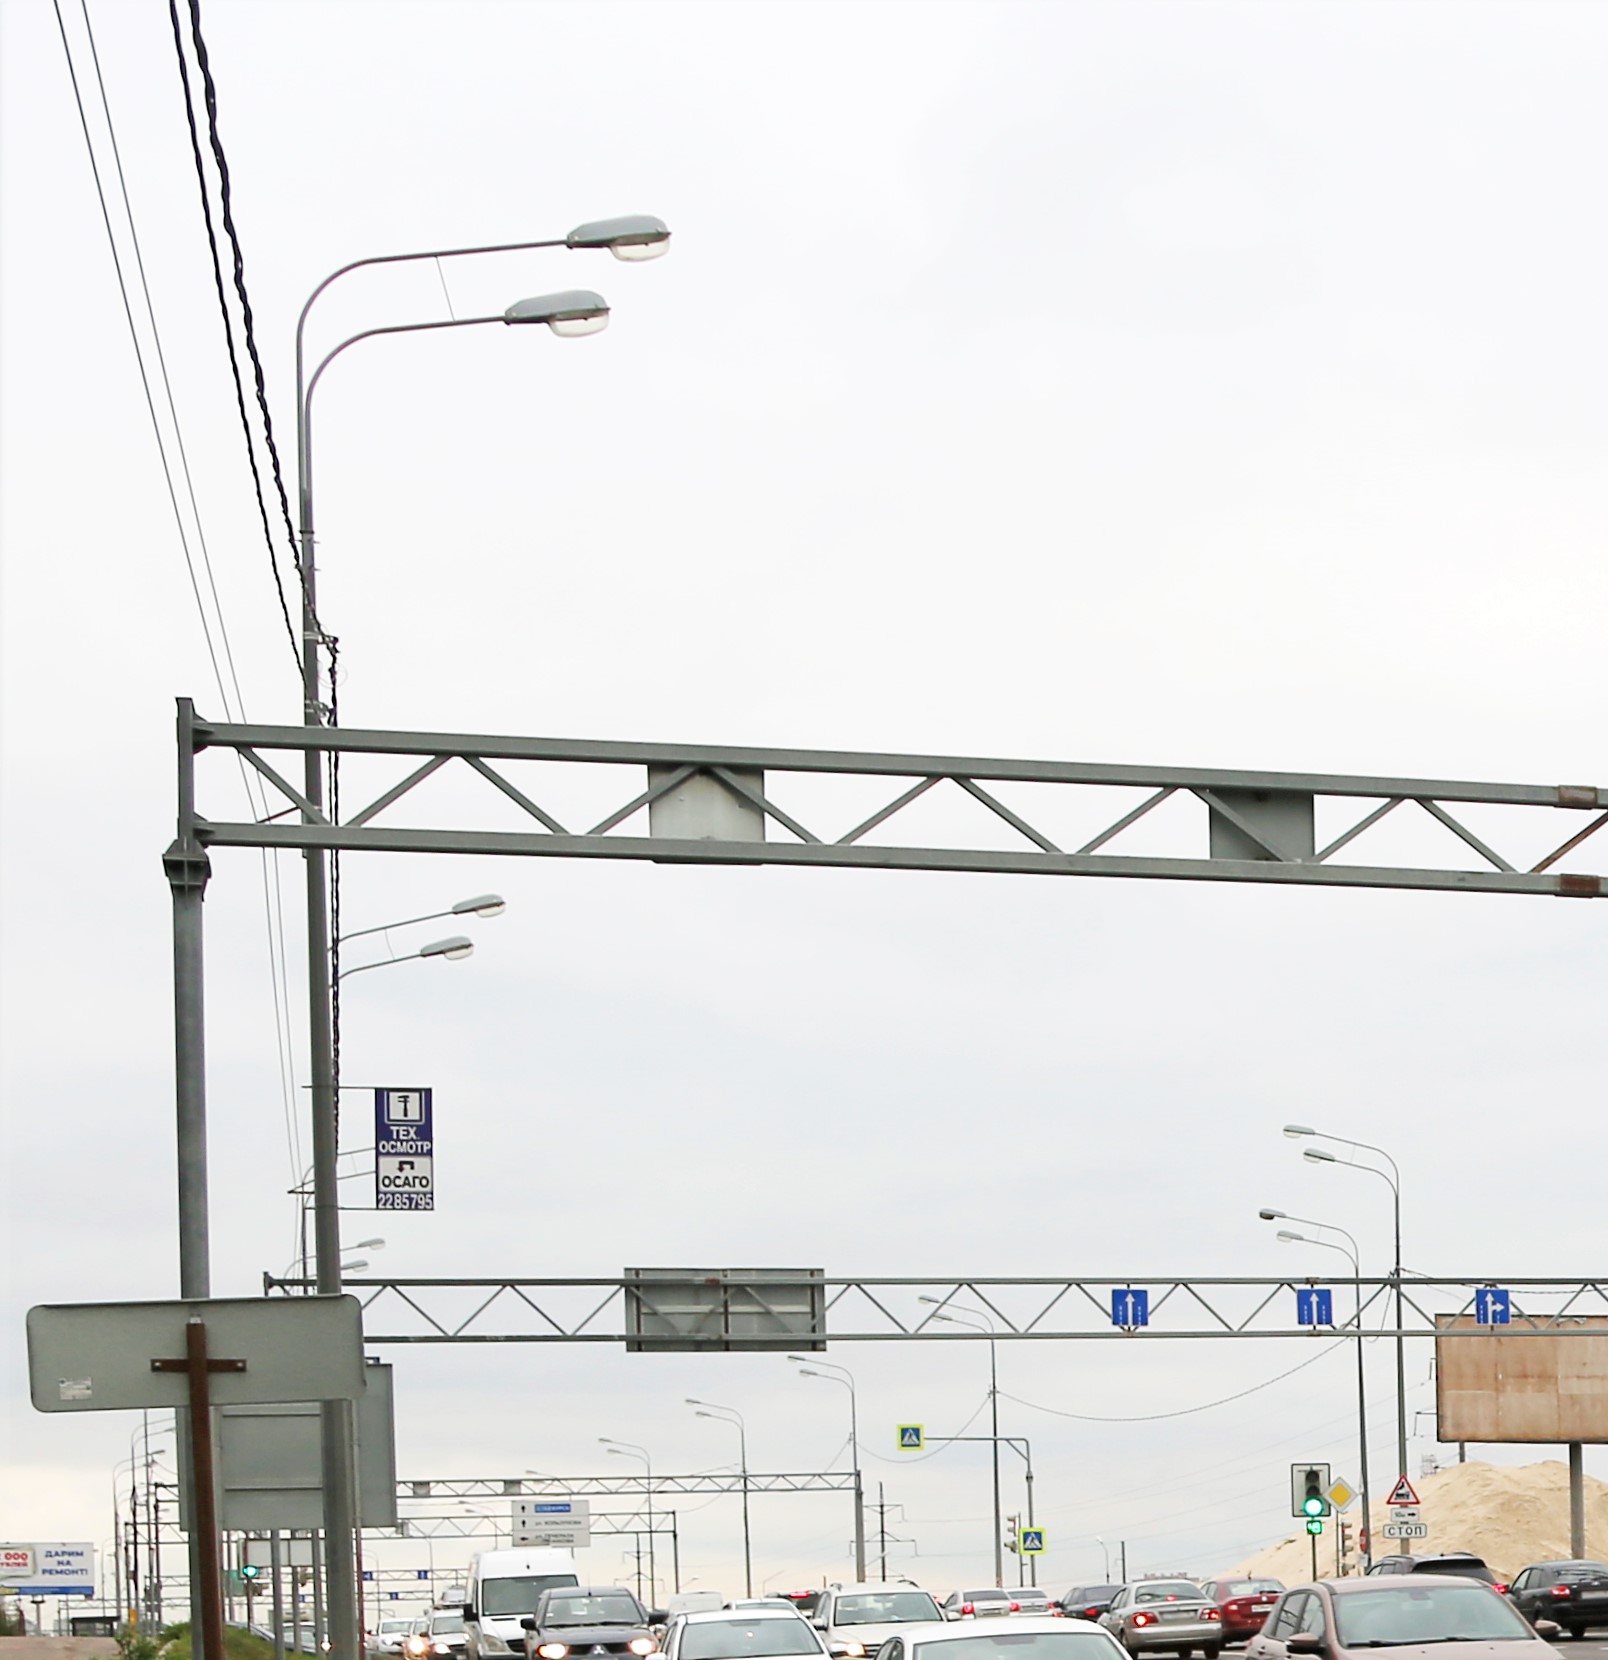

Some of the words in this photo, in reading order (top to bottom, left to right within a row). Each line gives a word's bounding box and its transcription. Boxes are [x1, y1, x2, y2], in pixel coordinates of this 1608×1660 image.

[378, 1141, 432, 1154] ОСМОТР
[381, 1175, 430, 1188] ОСАГО
[377, 1193, 433, 1209] 2285795
[1388, 1526, 1422, 1536] СТОП
[45, 1550, 84, 1558] ДАРИМ
[41, 1568, 88, 1576] РЕМОНТ!
